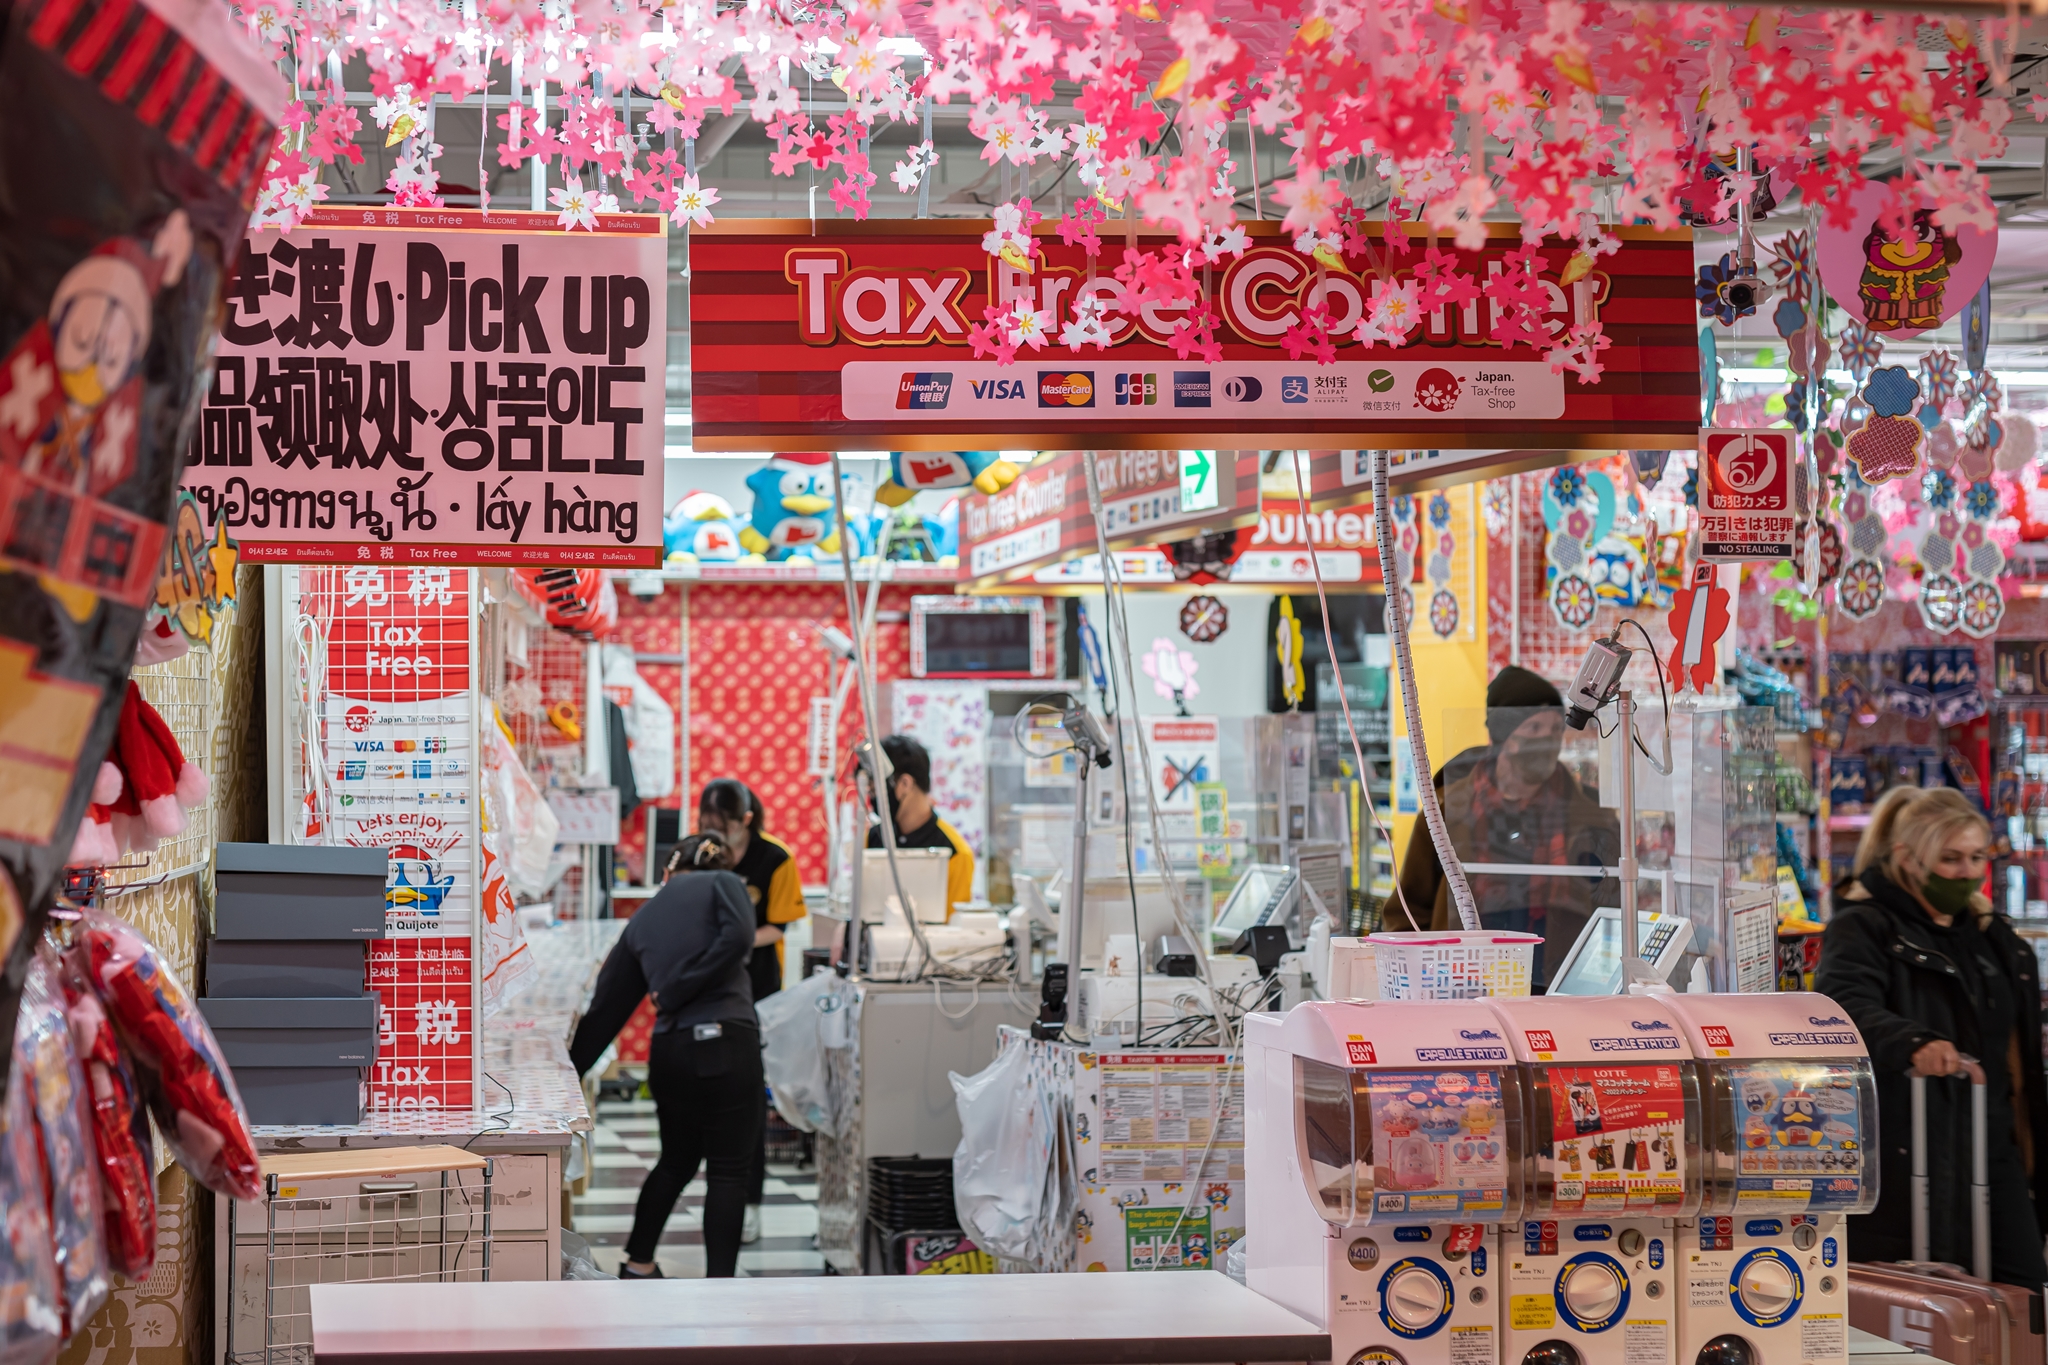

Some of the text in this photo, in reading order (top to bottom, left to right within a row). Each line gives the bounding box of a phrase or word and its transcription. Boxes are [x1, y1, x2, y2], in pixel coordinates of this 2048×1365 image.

[415, 214, 462, 226] Tax Free
[482, 217, 517, 225] WELCOME
[527, 218, 555, 227] 欢迎光临
[793, 257, 964, 335] Tax
[563, 275, 650, 366] up
[1313, 376, 1348, 388] 支付宝
[1475, 371, 1514, 382] Japan.
[901, 381, 950, 395] UnionPay
[967, 380, 1026, 400] VISA
[1041, 383, 1092, 396] MasterCard
[1114, 383, 1156, 396] JCB
[1471, 385, 1515, 396] Tax-free
[1362, 401, 1401, 411] 微信支付
[1488, 397, 1516, 411] Shop
[988, 492, 1017, 529] Free
[1016, 468, 1068, 521] Counter
[1713, 494, 1781, 509] 防犯カメラ
[544, 482, 638, 544] hàng
[1700, 516, 1793, 532] 万引きは犯罪
[1707, 532, 1787, 542] 警察に通報します
[265, 548, 288, 556] 오세요
[410, 548, 458, 559] Tax Free
[477, 550, 512, 558] WELCOME
[522, 551, 550, 559] 欢迎光临
[1719, 545, 1779, 554] NO STEALING
[559, 551, 595, 560] 어서 오세요
[370, 621, 424, 647] Tax
[366, 651, 433, 677] Free
[354, 741, 385, 752] VISA
[399, 812, 448, 833] enjoy
[397, 921, 439, 932] Quijote
[1528, 1032, 1552, 1041] BAN
[1704, 1028, 1728, 1037] BAN
[1531, 1041, 1550, 1049] DAI
[1708, 1036, 1727, 1045] DAI
[1348, 1044, 1373, 1052] BAN
[1352, 1053, 1370, 1061] DAI
[377, 1061, 431, 1086] Tax
[1594, 1070, 1628, 1078] LOTTE
[1596, 1079, 1651, 1087] マスコットチャーム
[373, 1091, 440, 1113] Free
[1144, 1210, 1180, 1219] shopping
[1128, 1221, 1148, 1229] bags
[1350, 1247, 1376, 1259] ¥400
